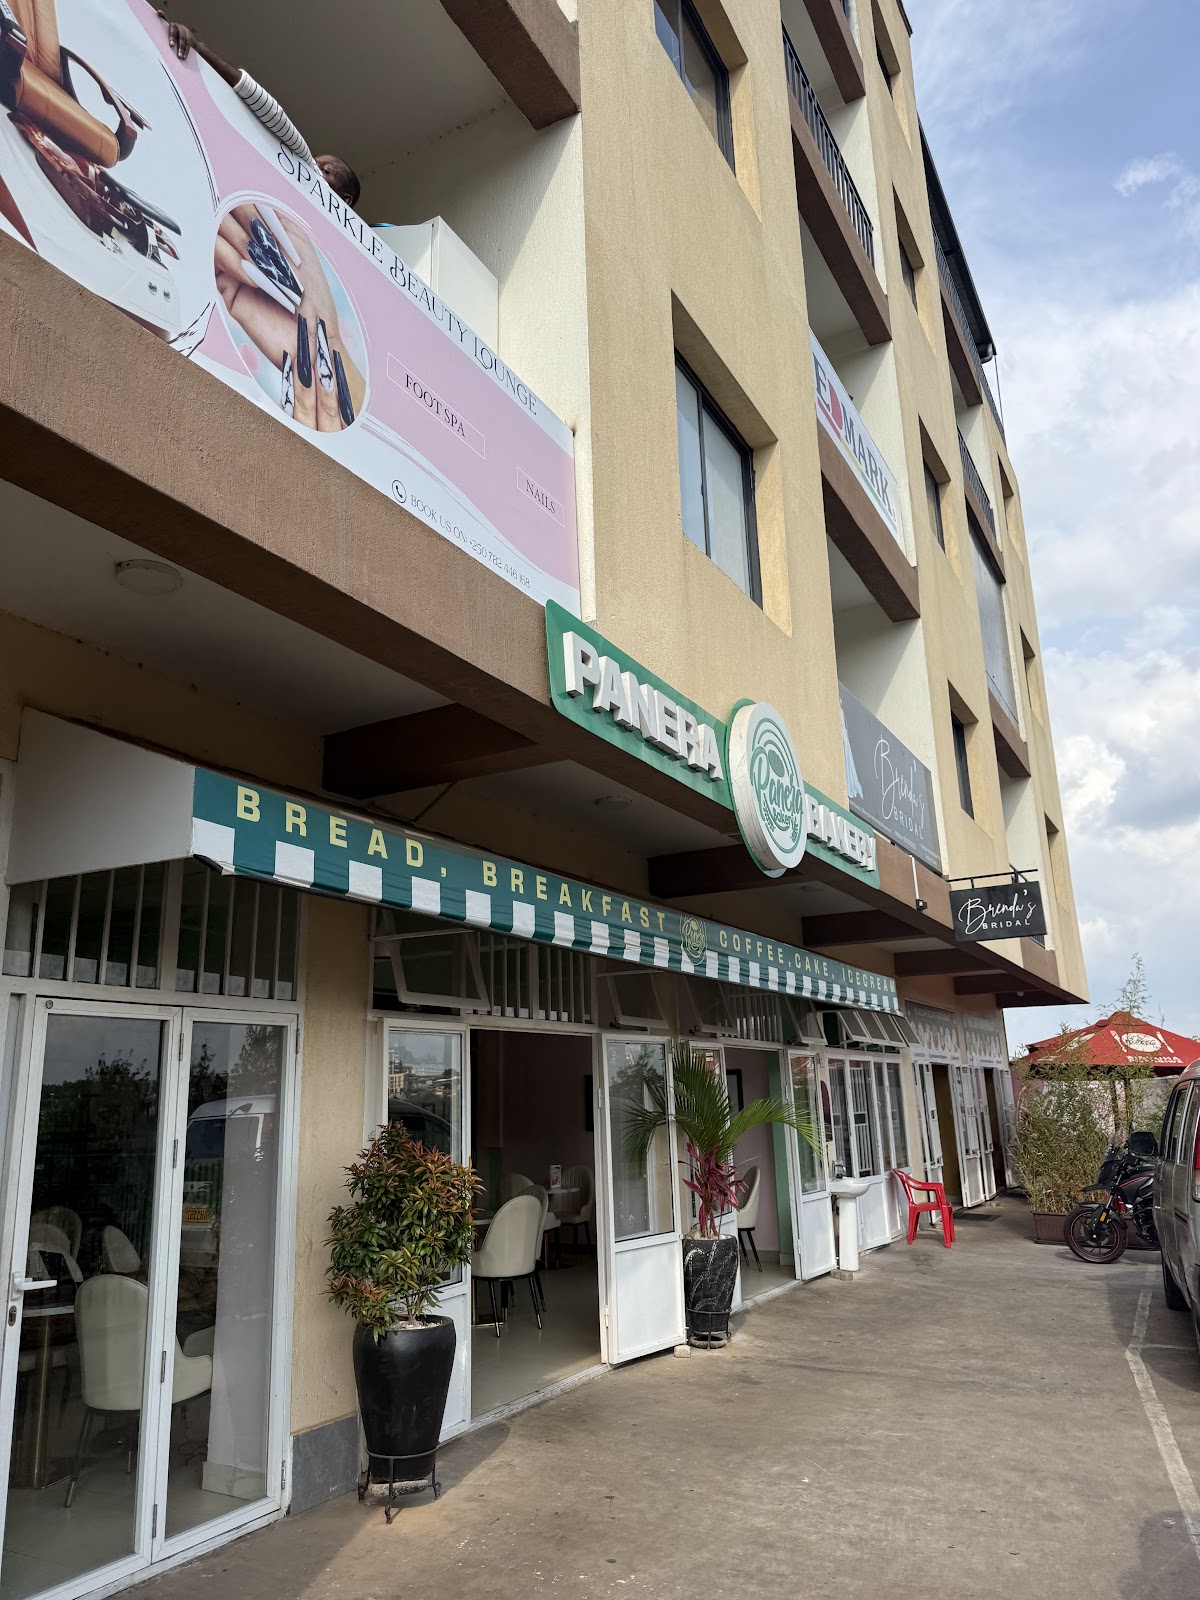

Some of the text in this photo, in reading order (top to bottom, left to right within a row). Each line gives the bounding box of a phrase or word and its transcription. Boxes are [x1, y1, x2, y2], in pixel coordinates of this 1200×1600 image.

[277, 142, 537, 415] SPARKLE BEAUTY LOUNGE
[405, 374, 465, 437] FOOT SPA
[410, 494, 439, 523] BOOK
[439, 515, 452, 533] US
[488, 551, 502, 569] 782
[526, 479, 556, 515] NAILS
[563, 631, 724, 782] PANERA
[750, 745, 804, 823] Panera
[873, 733, 926, 830] Brenda's
[236, 784, 665, 932] BREAD, BREAKFAST
[805, 793, 877, 873] BAKERY
[893, 805, 925, 840] BRIDAL
[957, 888, 1037, 935] Brenda's
[982, 918, 1031, 930] BRIDAL
[842, 968, 897, 993] ICECREAM
